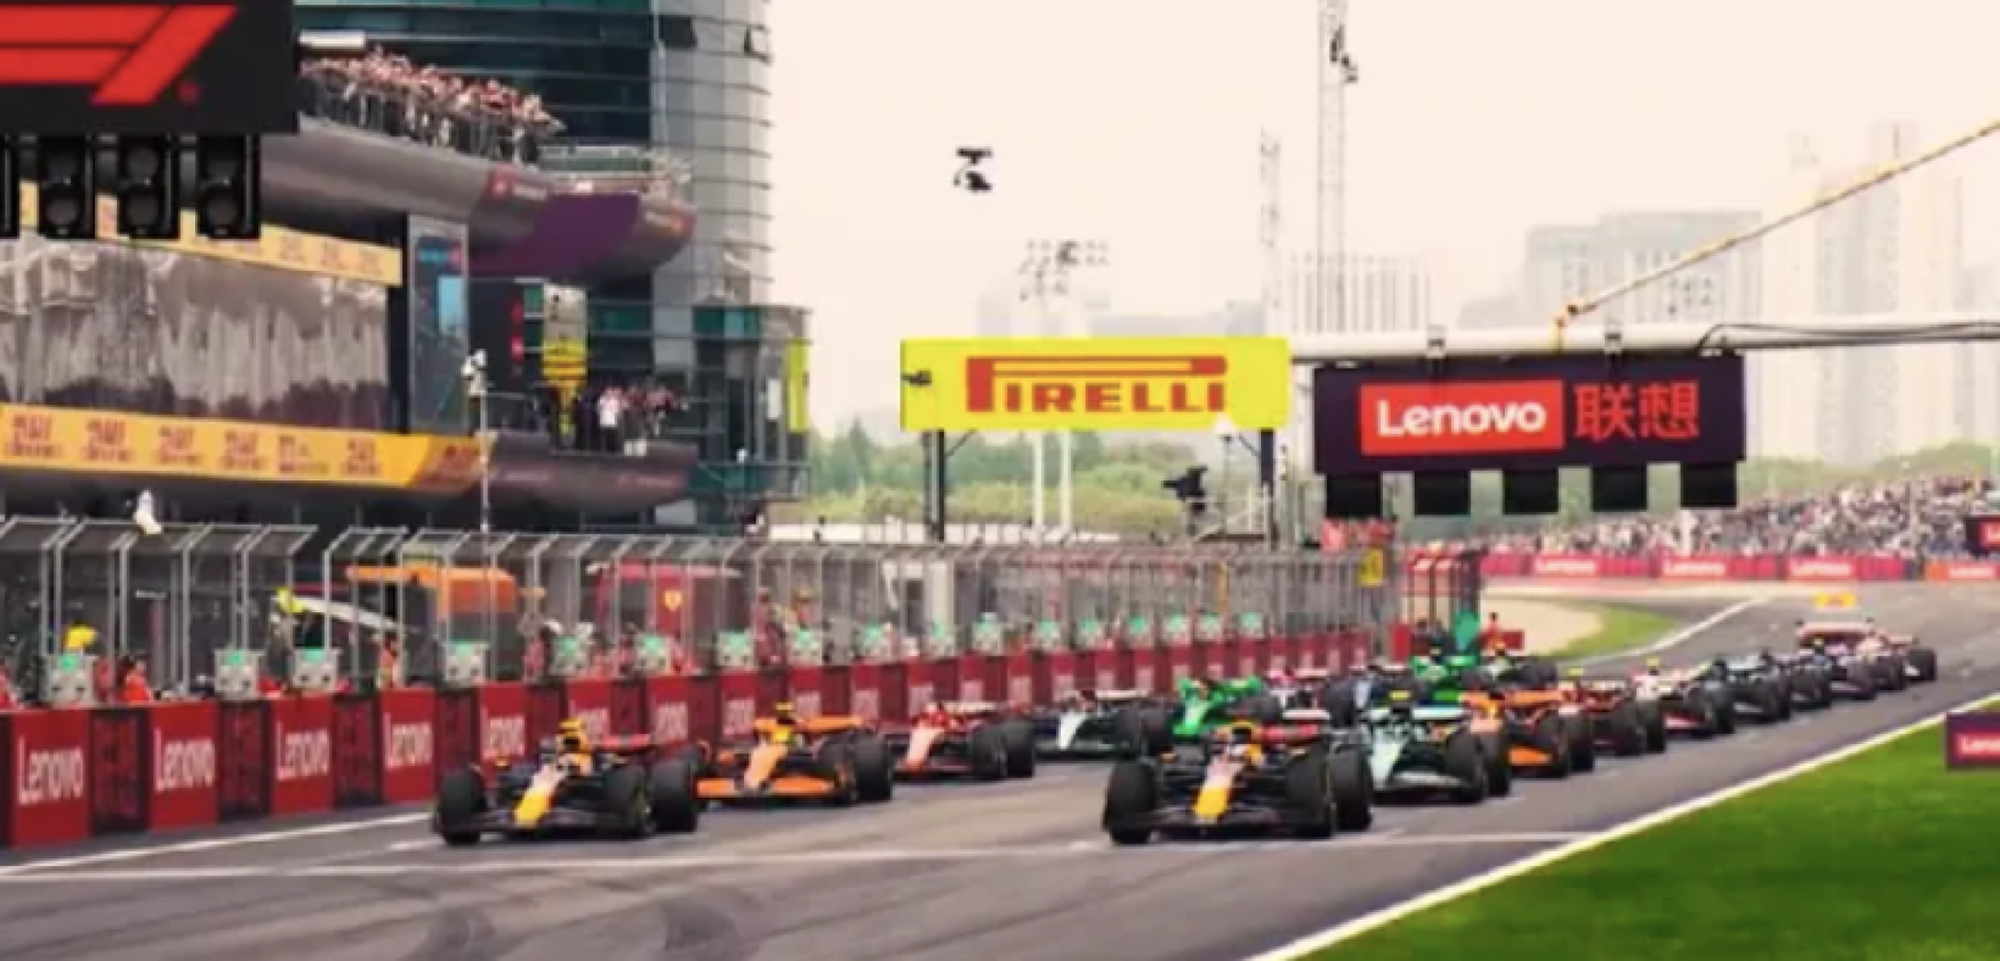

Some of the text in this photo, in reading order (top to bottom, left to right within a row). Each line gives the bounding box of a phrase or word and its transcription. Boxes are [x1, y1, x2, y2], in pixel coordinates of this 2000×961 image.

[966, 355, 1228, 412] PIRELLI
[1377, 380, 1698, 441] Lenovo 联想
[19, 737, 83, 805] Lenovo
[155, 728, 215, 791] Lenovo
[276, 721, 330, 781] Lenovo
[383, 713, 432, 770] Lenovo
